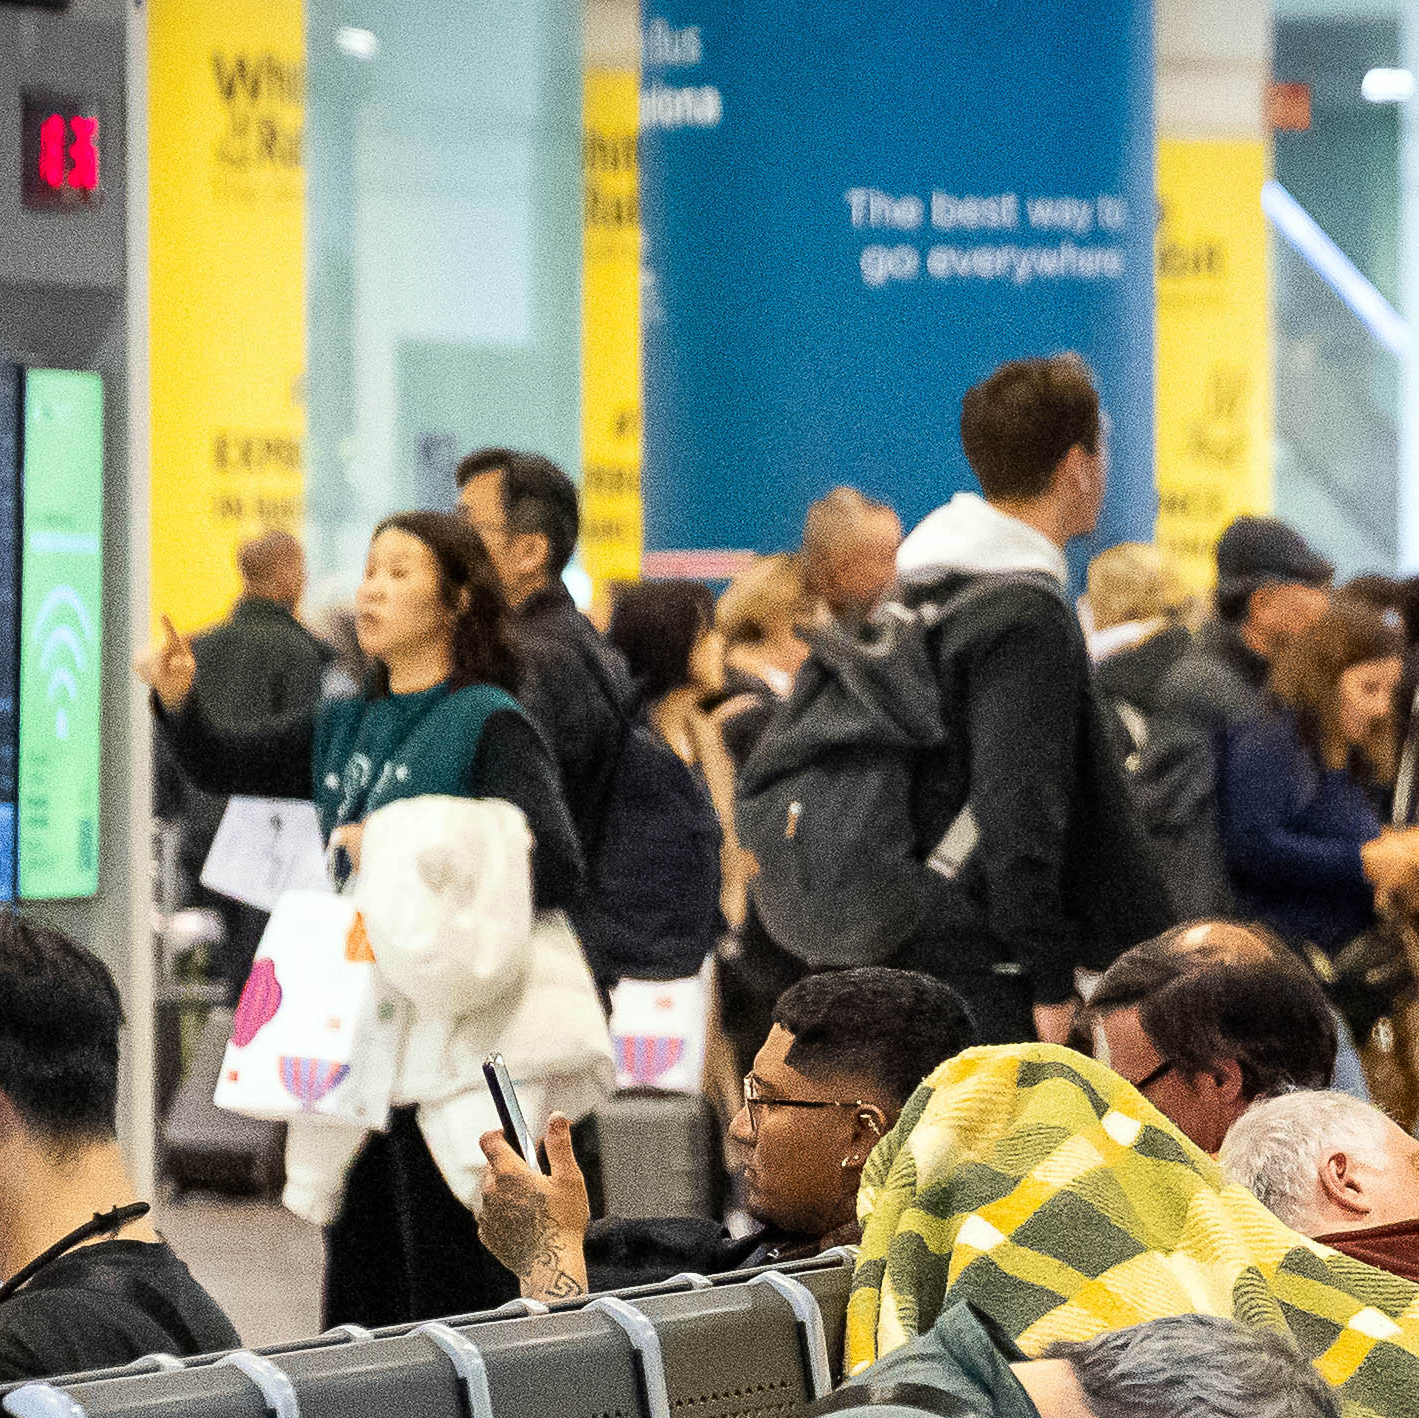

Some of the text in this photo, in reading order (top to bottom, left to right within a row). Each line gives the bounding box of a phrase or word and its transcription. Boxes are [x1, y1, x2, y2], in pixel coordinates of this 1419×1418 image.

[845, 187, 923, 229] The
[931, 188, 1017, 229] best
[1026, 195, 1093, 236] way
[860, 245, 919, 289] go
